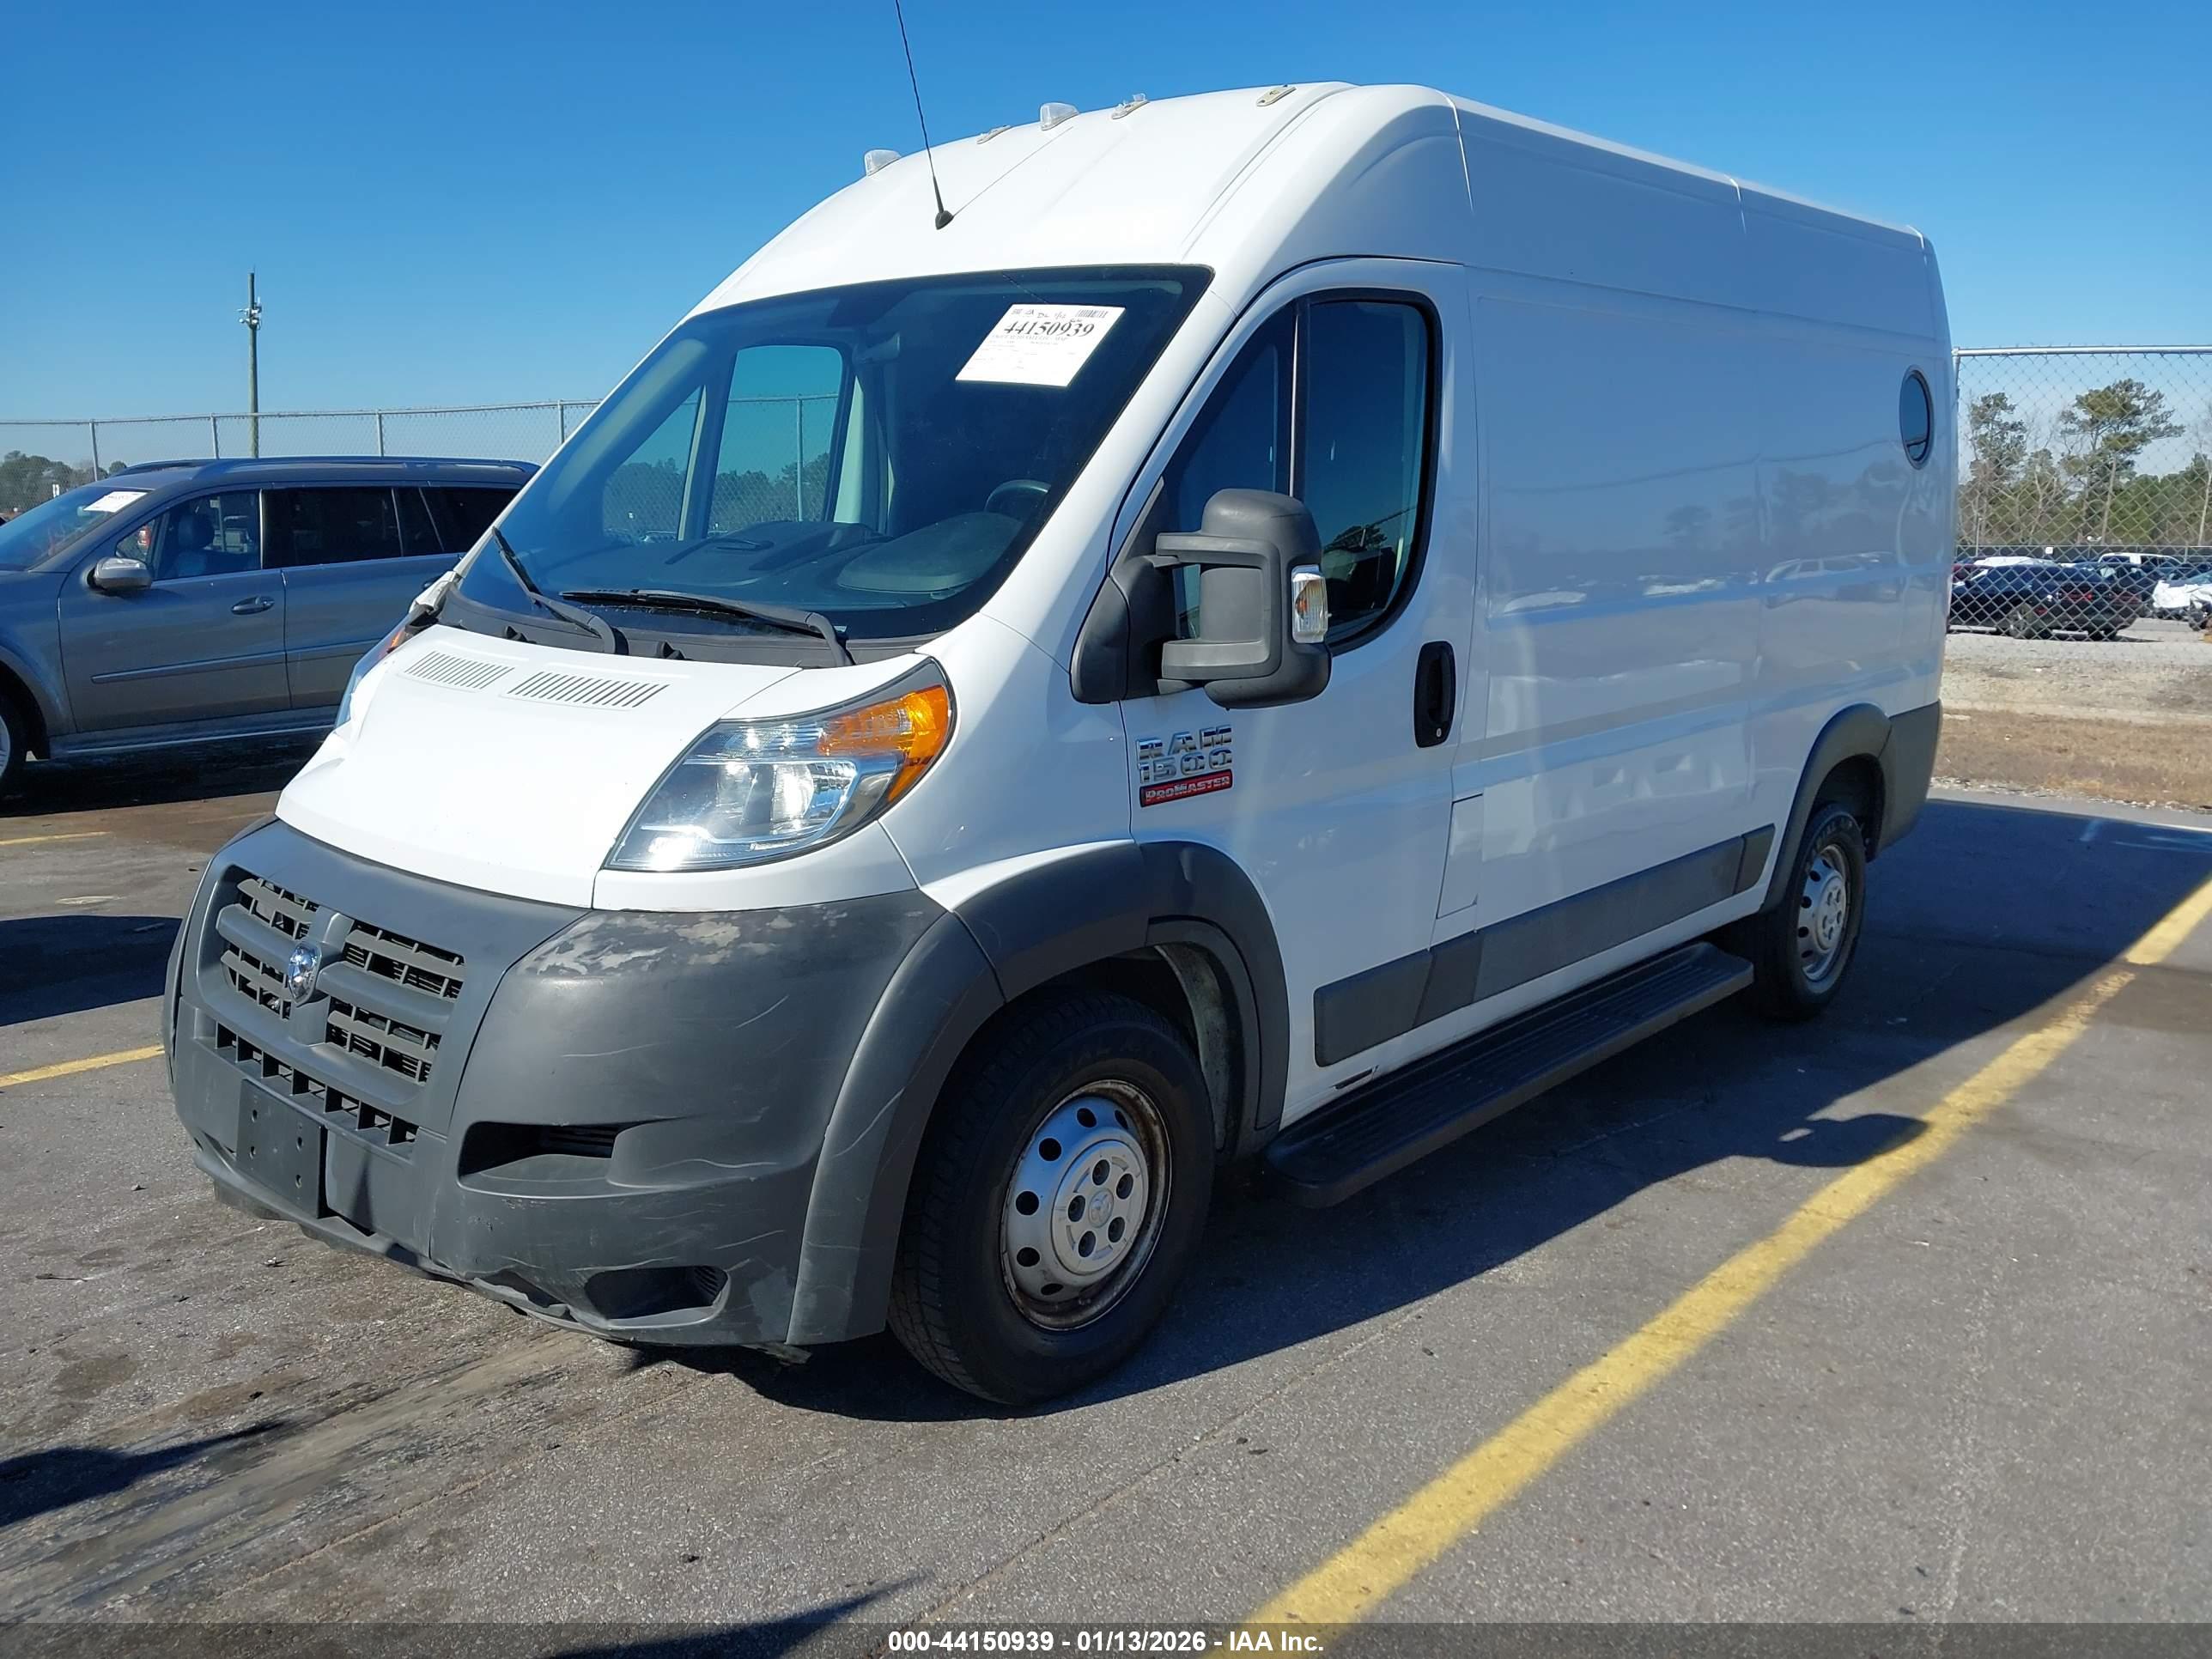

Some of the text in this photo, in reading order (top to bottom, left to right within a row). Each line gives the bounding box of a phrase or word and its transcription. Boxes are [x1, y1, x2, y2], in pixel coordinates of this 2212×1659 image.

[1004, 320, 1096, 337] 44150939
[1135, 724, 1232, 763] RAM
[1137, 746, 1233, 784] 1500
